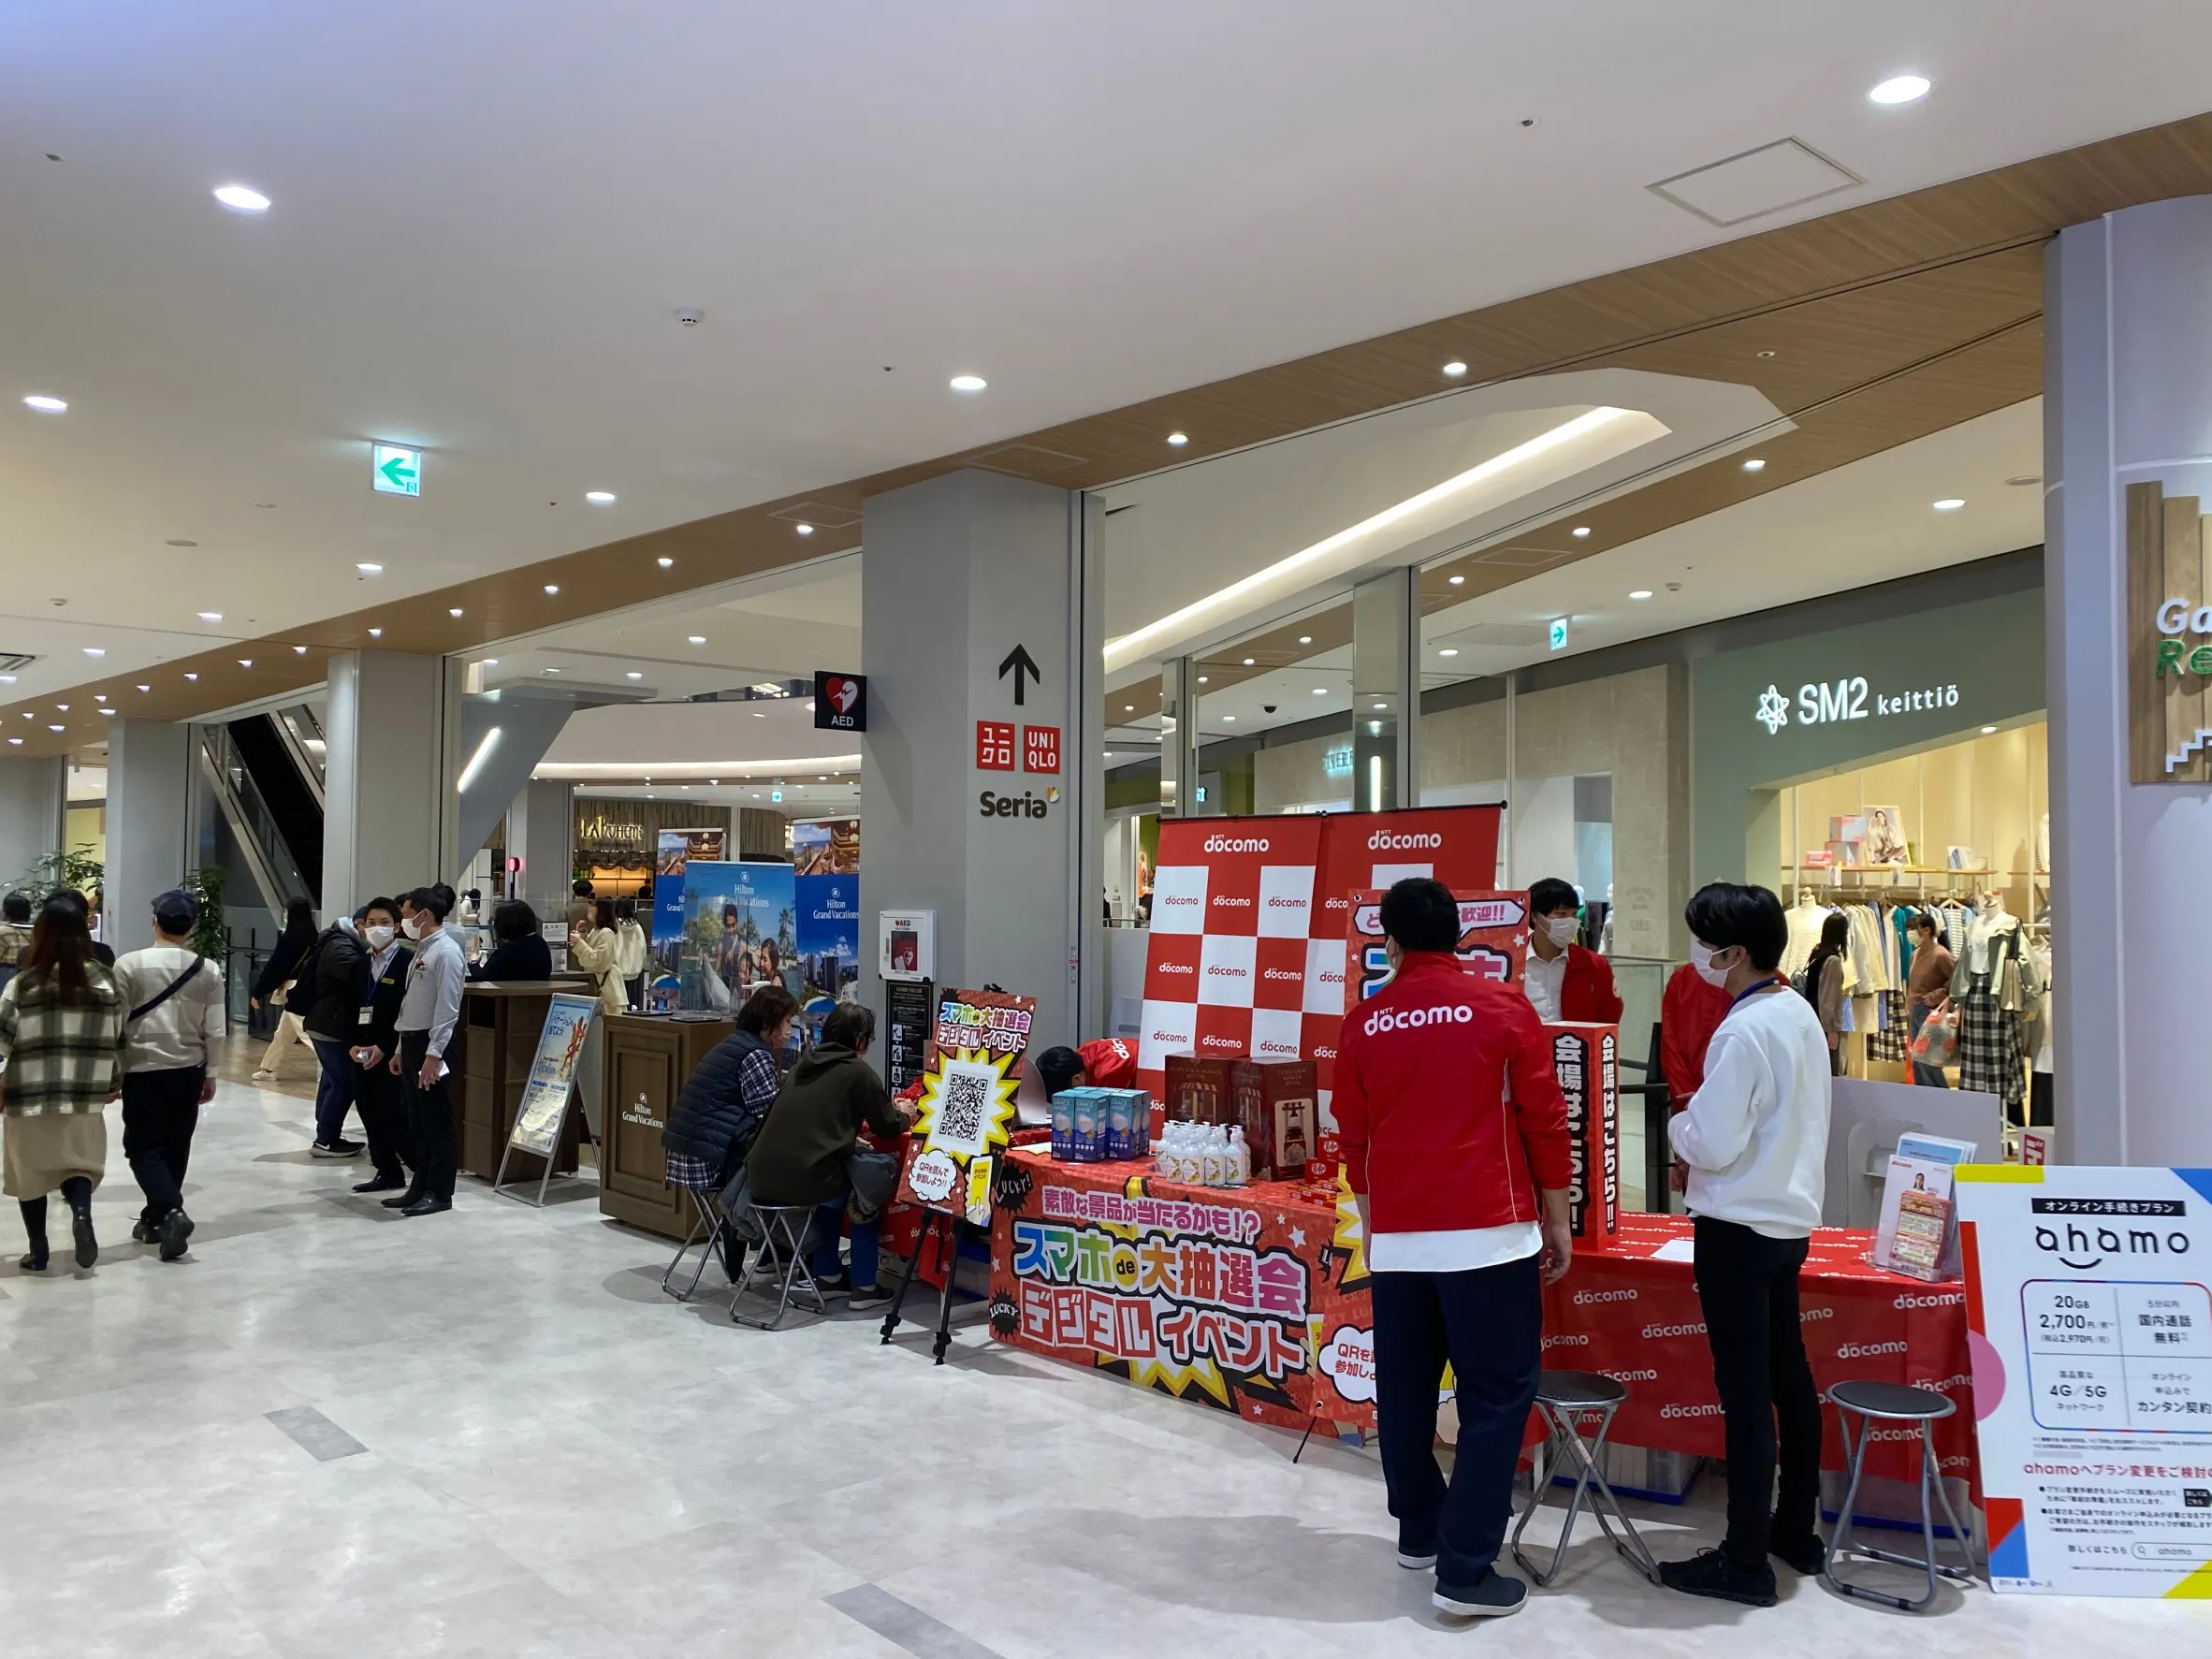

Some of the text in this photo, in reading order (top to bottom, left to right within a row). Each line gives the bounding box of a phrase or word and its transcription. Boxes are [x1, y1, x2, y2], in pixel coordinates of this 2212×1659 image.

[1797, 676, 1959, 724] SM2 keittiö
[830, 715, 853, 727] AED
[982, 727, 1011, 745] ユニ
[1028, 731, 1055, 749] UNI
[982, 747, 1011, 764] クロ
[1028, 750, 1056, 769] QLO
[980, 791, 1048, 820] Seria
[1203, 834, 1270, 852] docomo
[1367, 830, 1442, 851] docomo
[734, 883, 755, 895] Hilton
[719, 895, 770, 909] Grand Vacations
[826, 899, 847, 910] Hilton
[1165, 895, 1199, 906] docomo
[1213, 895, 1251, 907] docomo
[1268, 895, 1307, 908] docomo
[1325, 897, 1348, 909] doco
[813, 910, 860, 921] Grand Vacations
[1457, 904, 1506, 923] 歓迎!!
[1158, 962, 1193, 974] docomo
[1207, 965, 1246, 977] docomo
[1264, 968, 1302, 981] docomo
[1319, 970, 1344, 982] doco
[1379, 1006, 1394, 1015] NTT
[1363, 1004, 1473, 1037] docomo
[1153, 1030, 1187, 1043] docomo
[1201, 1034, 1243, 1049] docomo
[1260, 1041, 1298, 1055] docomo
[634, 1102, 651, 1115] Hilton
[622, 1111, 663, 1128] Grand Vacations
[2045, 1201, 2175, 1214] オンライン手続きプラン
[2035, 1223, 2190, 1254] ahamo
[1573, 1288, 1638, 1305] docomo
[1893, 1292, 1965, 1310] docomo
[2054, 1295, 2090, 1310] 20GB
[989, 1303, 1018, 1319] LUCKY
[1799, 1307, 1834, 1322] omo
[2139, 1314, 2192, 1328] 国内通話
[1641, 1322, 1708, 1339] docomo
[1837, 1340, 1908, 1359] docomo
[2059, 1370, 2094, 1379] 高品質な
[2151, 1373, 2192, 1381] オンライン
[2154, 1387, 2190, 1396] 申込みで
[2056, 1403, 2104, 1411] ネットワーク
[2136, 1401, 2212, 1415] カンタン契約
[1867, 1427, 1924, 1442] ocomo
[2068, 1544, 2128, 1554] 詳しくはこちら
[2158, 1547, 2192, 1556] ahamo
